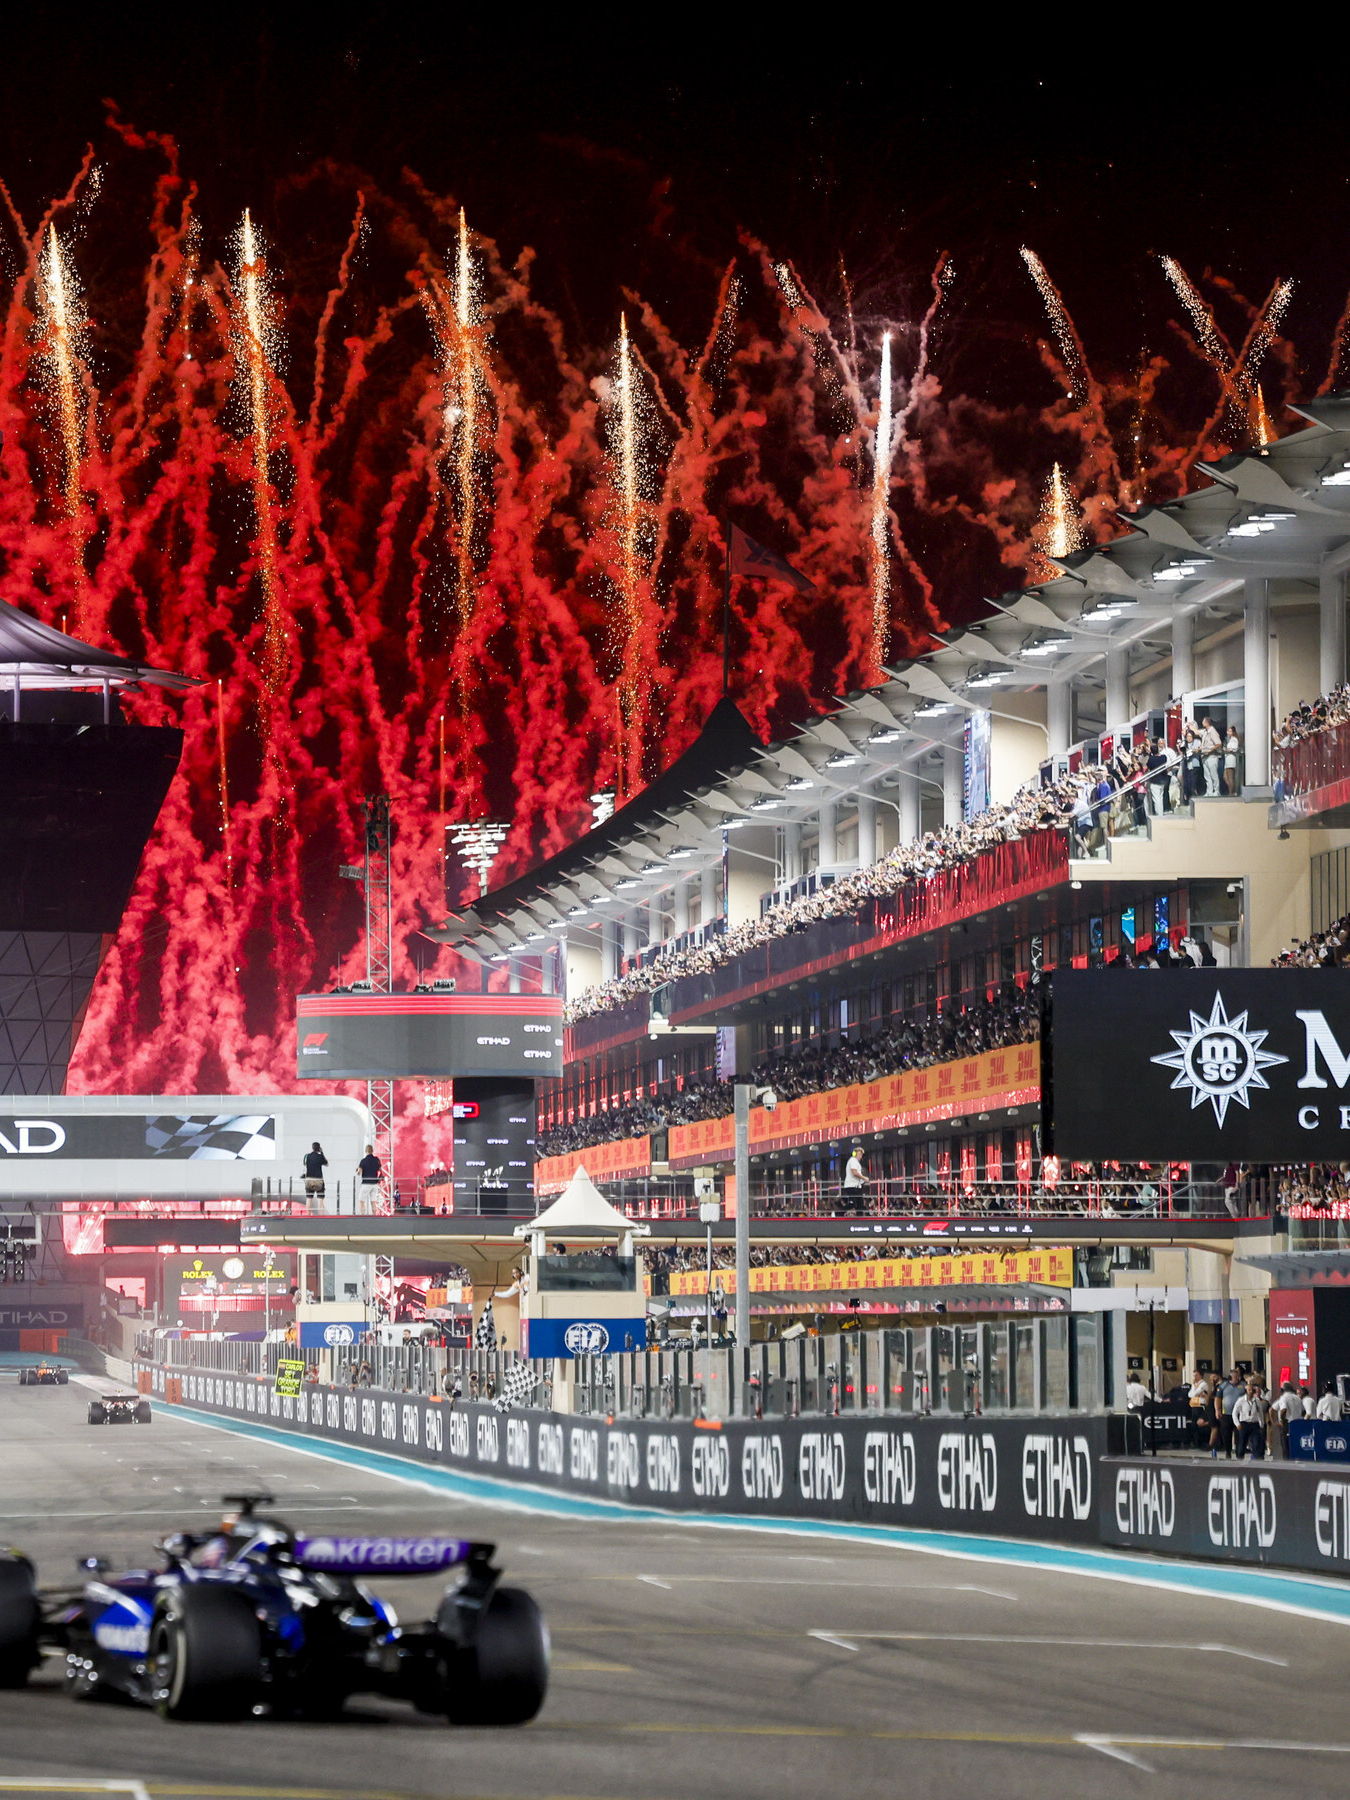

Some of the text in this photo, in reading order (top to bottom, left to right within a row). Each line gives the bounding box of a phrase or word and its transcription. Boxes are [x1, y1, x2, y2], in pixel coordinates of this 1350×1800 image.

[476, 1036, 511, 1045] ETIHAD
[182, 1271, 213, 1279] ROLEX
[253, 1270, 285, 1279] ROLEX
[285, 1363, 303, 1371] CARLOS
[1325, 1439, 1346, 1450] FIA
[570, 1428, 599, 1481] ETIHAD
[606, 1431, 640, 1488] ETIHAD
[647, 1435, 680, 1493] ETIHAD
[692, 1435, 729, 1496] ETIHAD
[742, 1434, 783, 1499] ETIHAD
[800, 1432, 845, 1500] ETIHAD
[864, 1432, 916, 1504] ETIHAD
[938, 1433, 997, 1512] ETIHAD
[1022, 1434, 1091, 1521] ETIHAD
[1115, 1468, 1176, 1537] ETIHAD
[1208, 1474, 1277, 1548] ETIHAD
[337, 1537, 460, 1565] kraken
